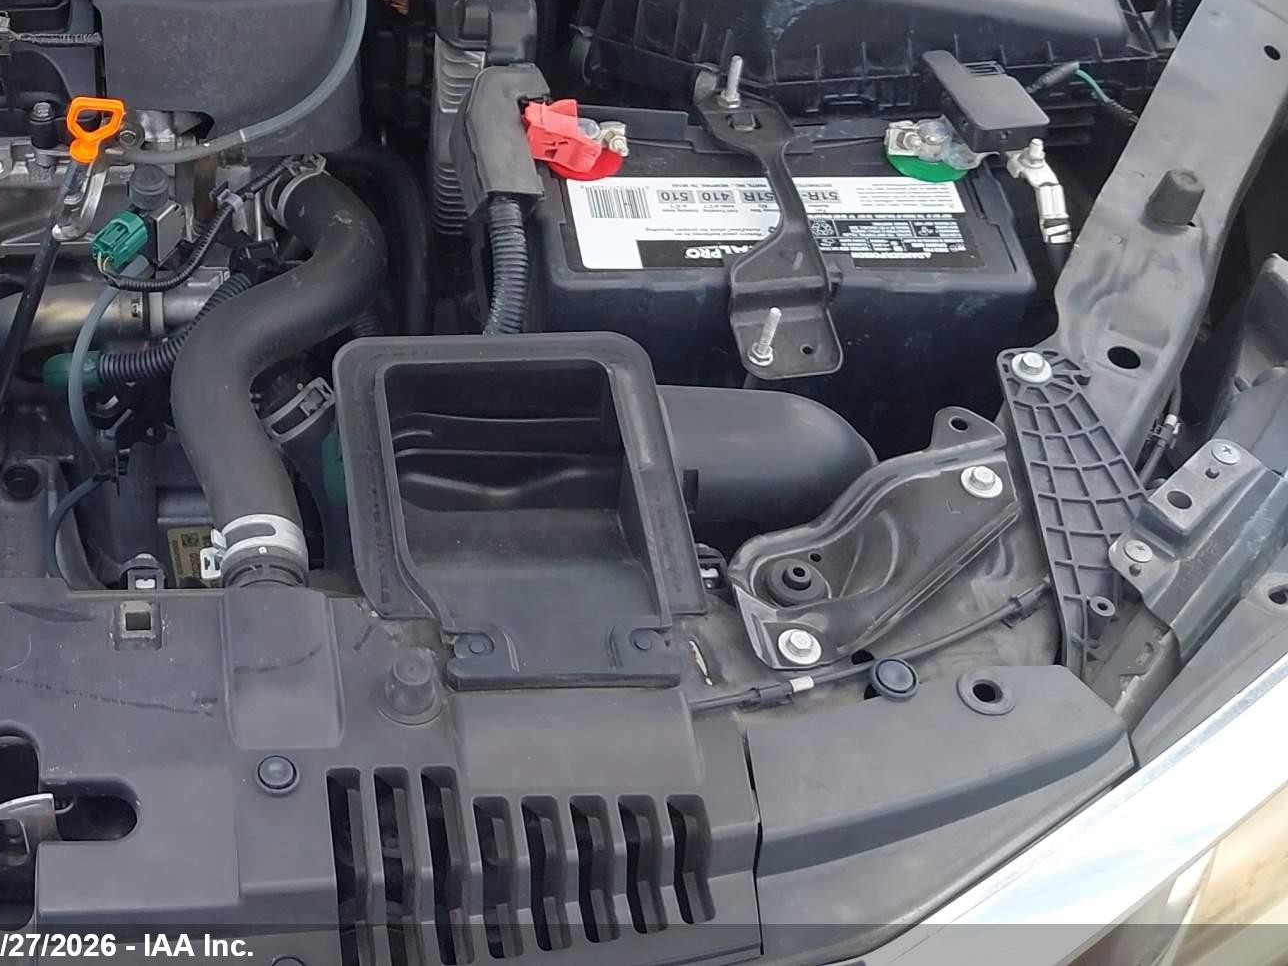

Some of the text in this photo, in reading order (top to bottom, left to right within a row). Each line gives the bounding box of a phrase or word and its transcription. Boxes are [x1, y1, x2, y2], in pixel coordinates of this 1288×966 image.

[660, 191, 689, 202] 510
[701, 191, 730, 202] 410
[742, 192, 775, 202] 51R
[685, 243, 753, 258] ALPRO
